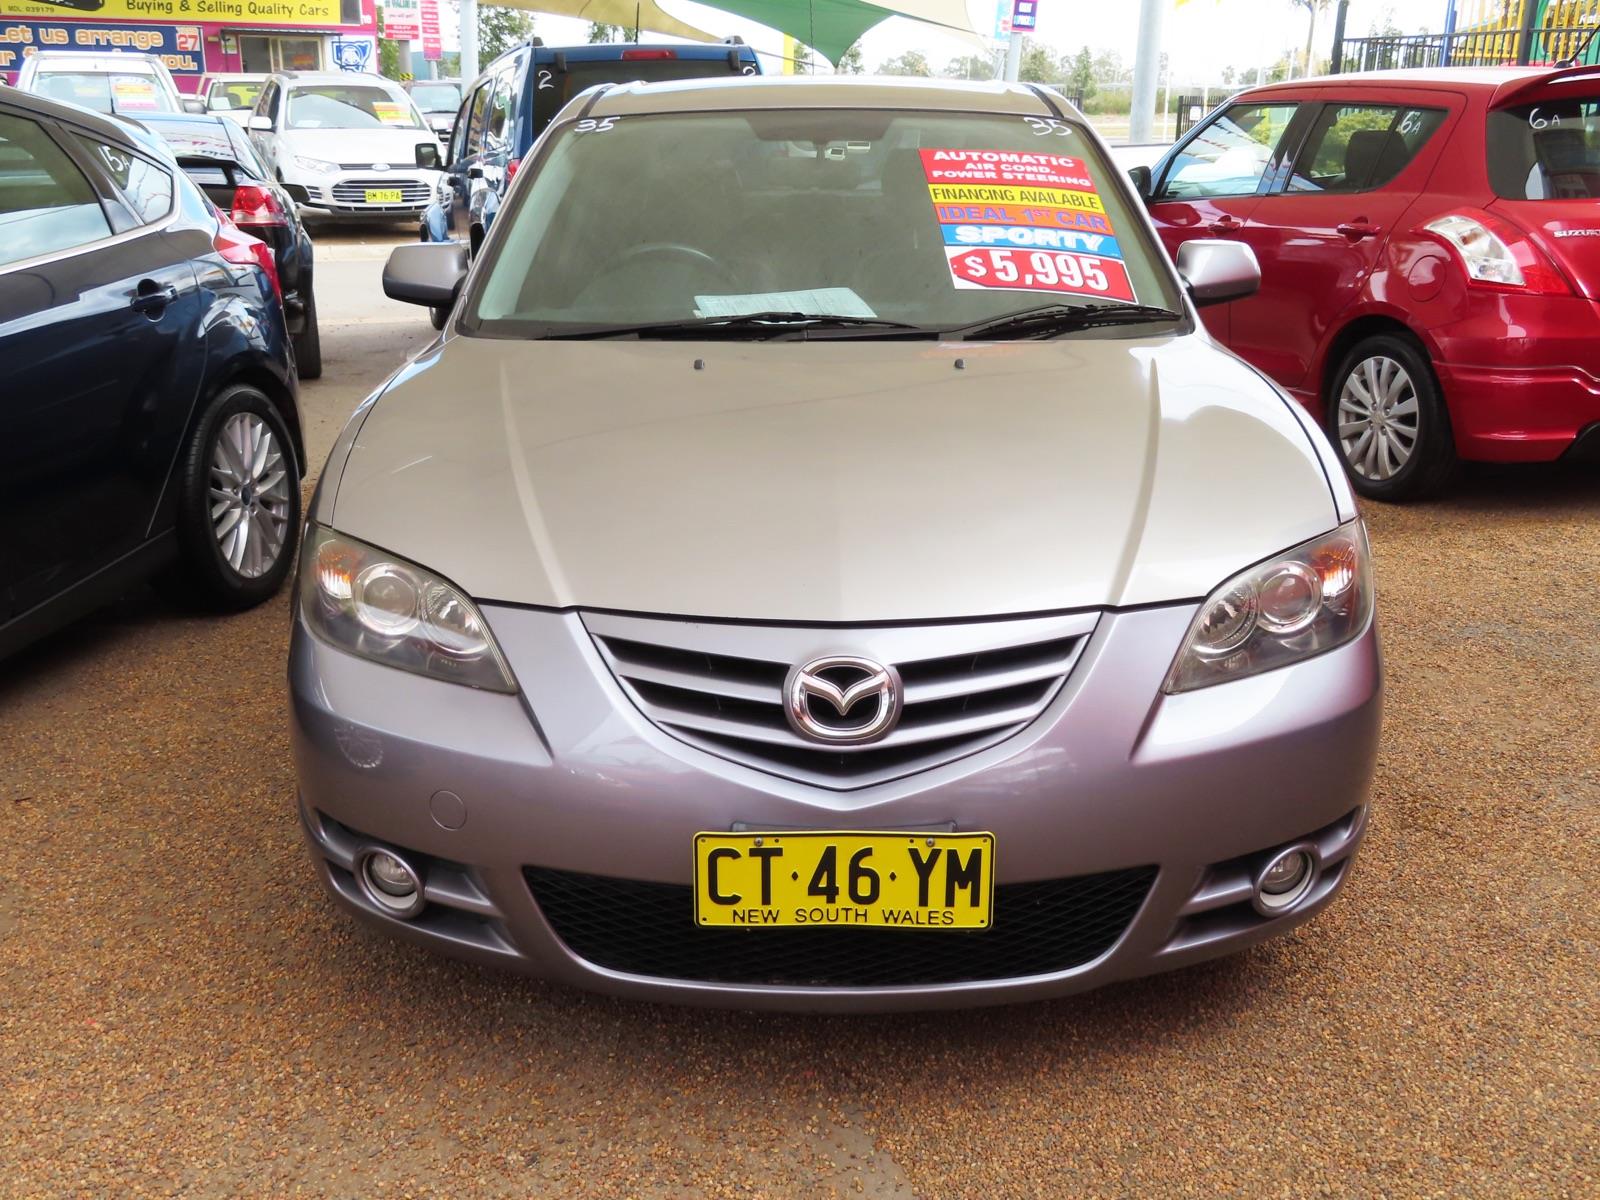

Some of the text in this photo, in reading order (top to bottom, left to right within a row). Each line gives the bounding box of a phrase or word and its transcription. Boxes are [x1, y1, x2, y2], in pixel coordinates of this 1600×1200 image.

[127, 0, 329, 18] Buying & Selling Quality Cars
[39, 28, 69, 44] us
[75, 29, 164, 50] arrange
[177, 34, 199, 51] 27
[538, 70, 554, 90] 2
[574, 116, 620, 132] 35
[1024, 117, 1072, 136] 35
[933, 151, 1075, 168] AUTOMATIC
[965, 163, 1056, 174] AIR COND.
[932, 170, 1092, 187] POWER STEERING
[932, 188, 1100, 210] FINANCING AVAILABLE
[940, 206, 1016, 222] IDEAL
[1056, 211, 1108, 231] CAR
[955, 225, 1104, 251] SPORTY
[732, 907, 954, 925] NEW SOUTH WALES
